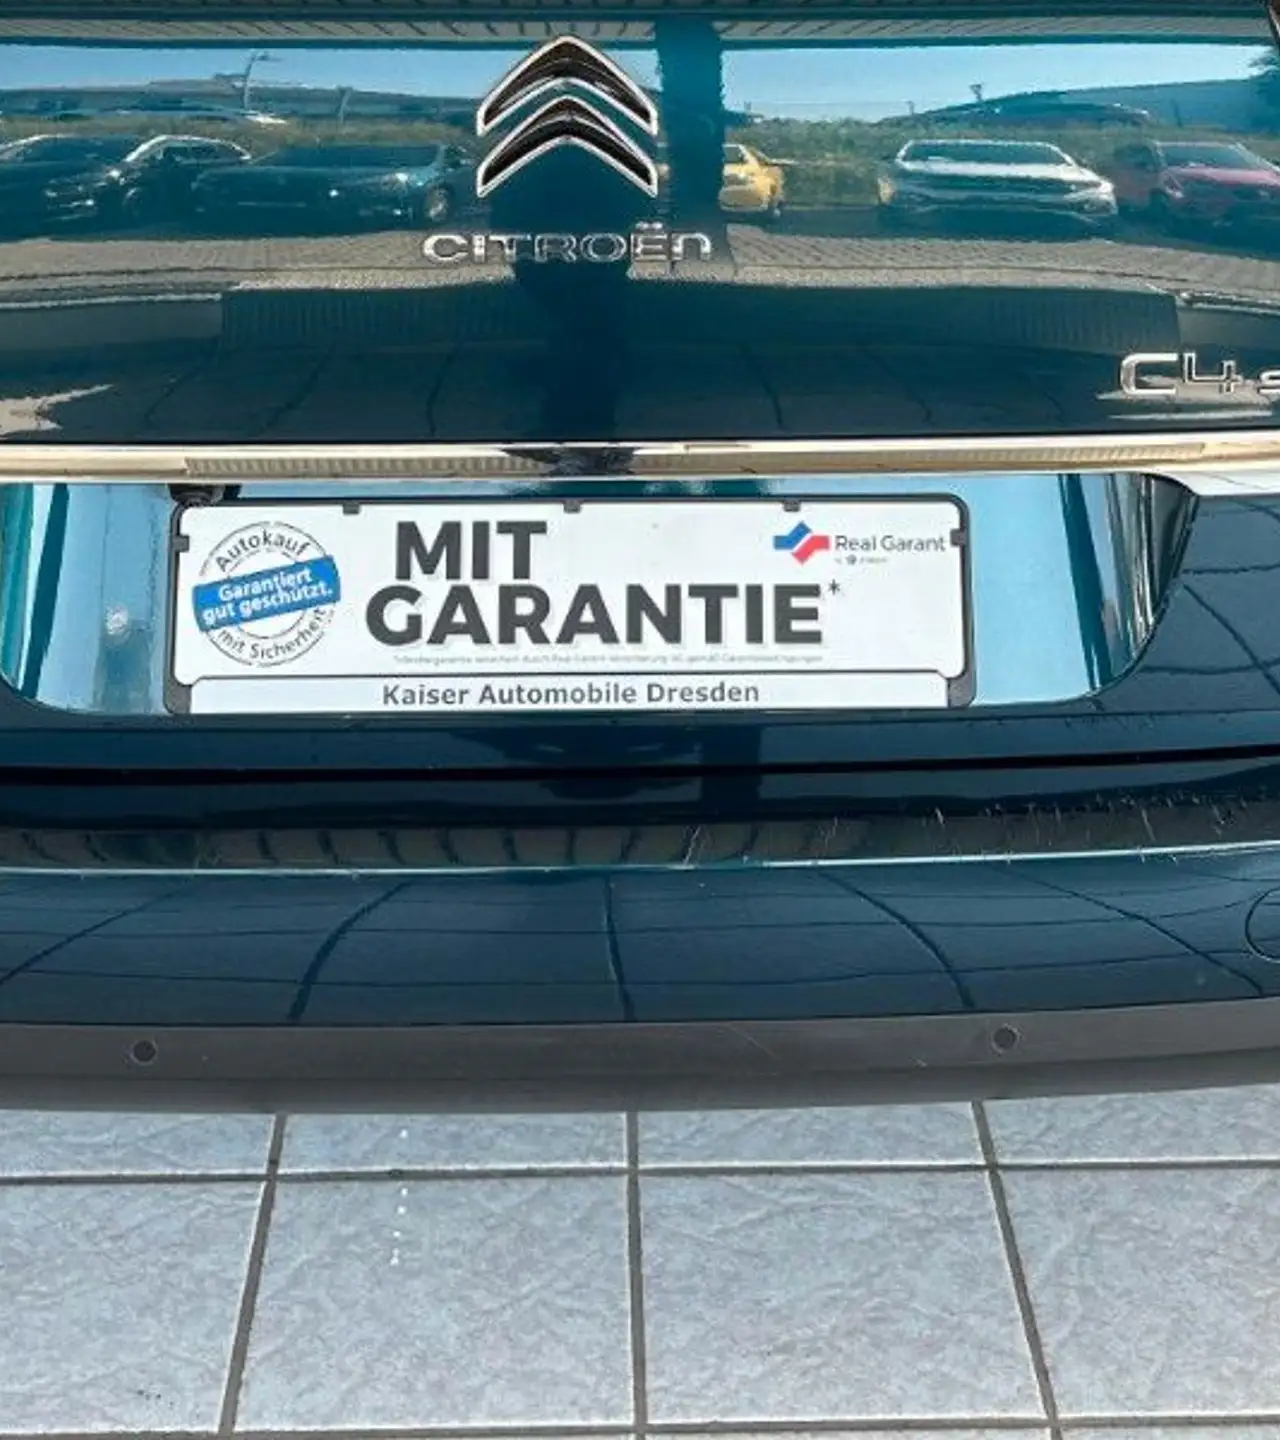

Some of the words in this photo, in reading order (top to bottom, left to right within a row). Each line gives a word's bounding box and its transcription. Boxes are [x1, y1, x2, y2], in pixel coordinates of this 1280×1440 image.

[1119, 350, 1240, 397] C4
[216, 529, 312, 573] Autokauf
[394, 519, 548, 582] MIT
[834, 534, 878, 553] Real
[880, 534, 947, 554] Garant
[218, 568, 313, 602] Garantiert
[202, 604, 236, 627] gut
[218, 628, 247, 654] mit
[382, 685, 469, 707] Kaiser
[478, 681, 638, 707] Automobile
[646, 680, 761, 704] Dresden
